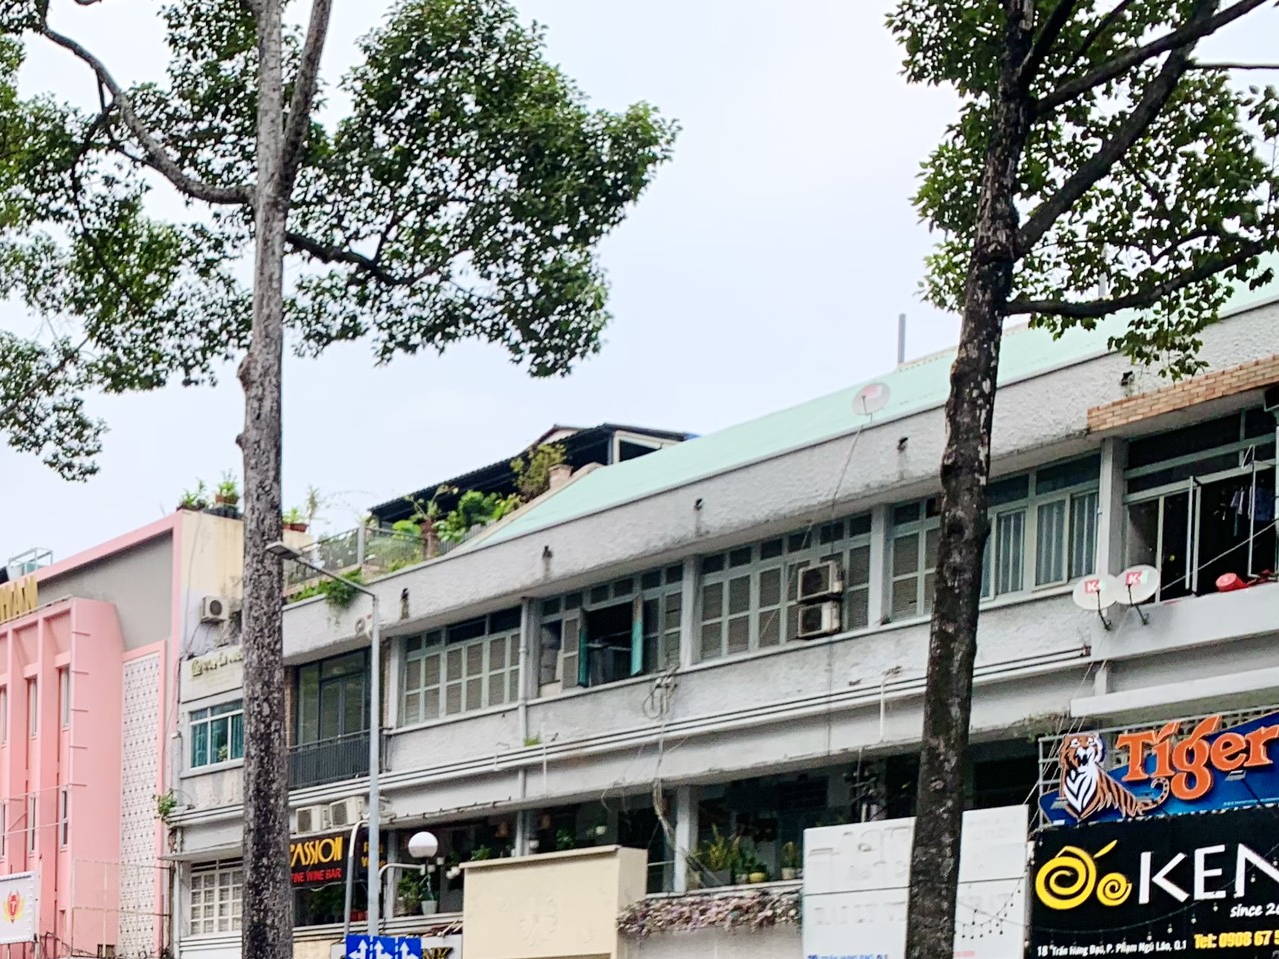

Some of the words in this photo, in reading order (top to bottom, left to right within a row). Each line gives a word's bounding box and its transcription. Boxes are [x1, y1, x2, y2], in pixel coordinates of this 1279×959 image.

[1116, 714, 1279, 800] Tiger
[326, 867, 342, 880] BAR
[1229, 903, 1263, 918] since
[1219, 931, 1252, 948] 0908
[1253, 930, 1273, 946] 67
[1037, 945, 1048, 957] 18
